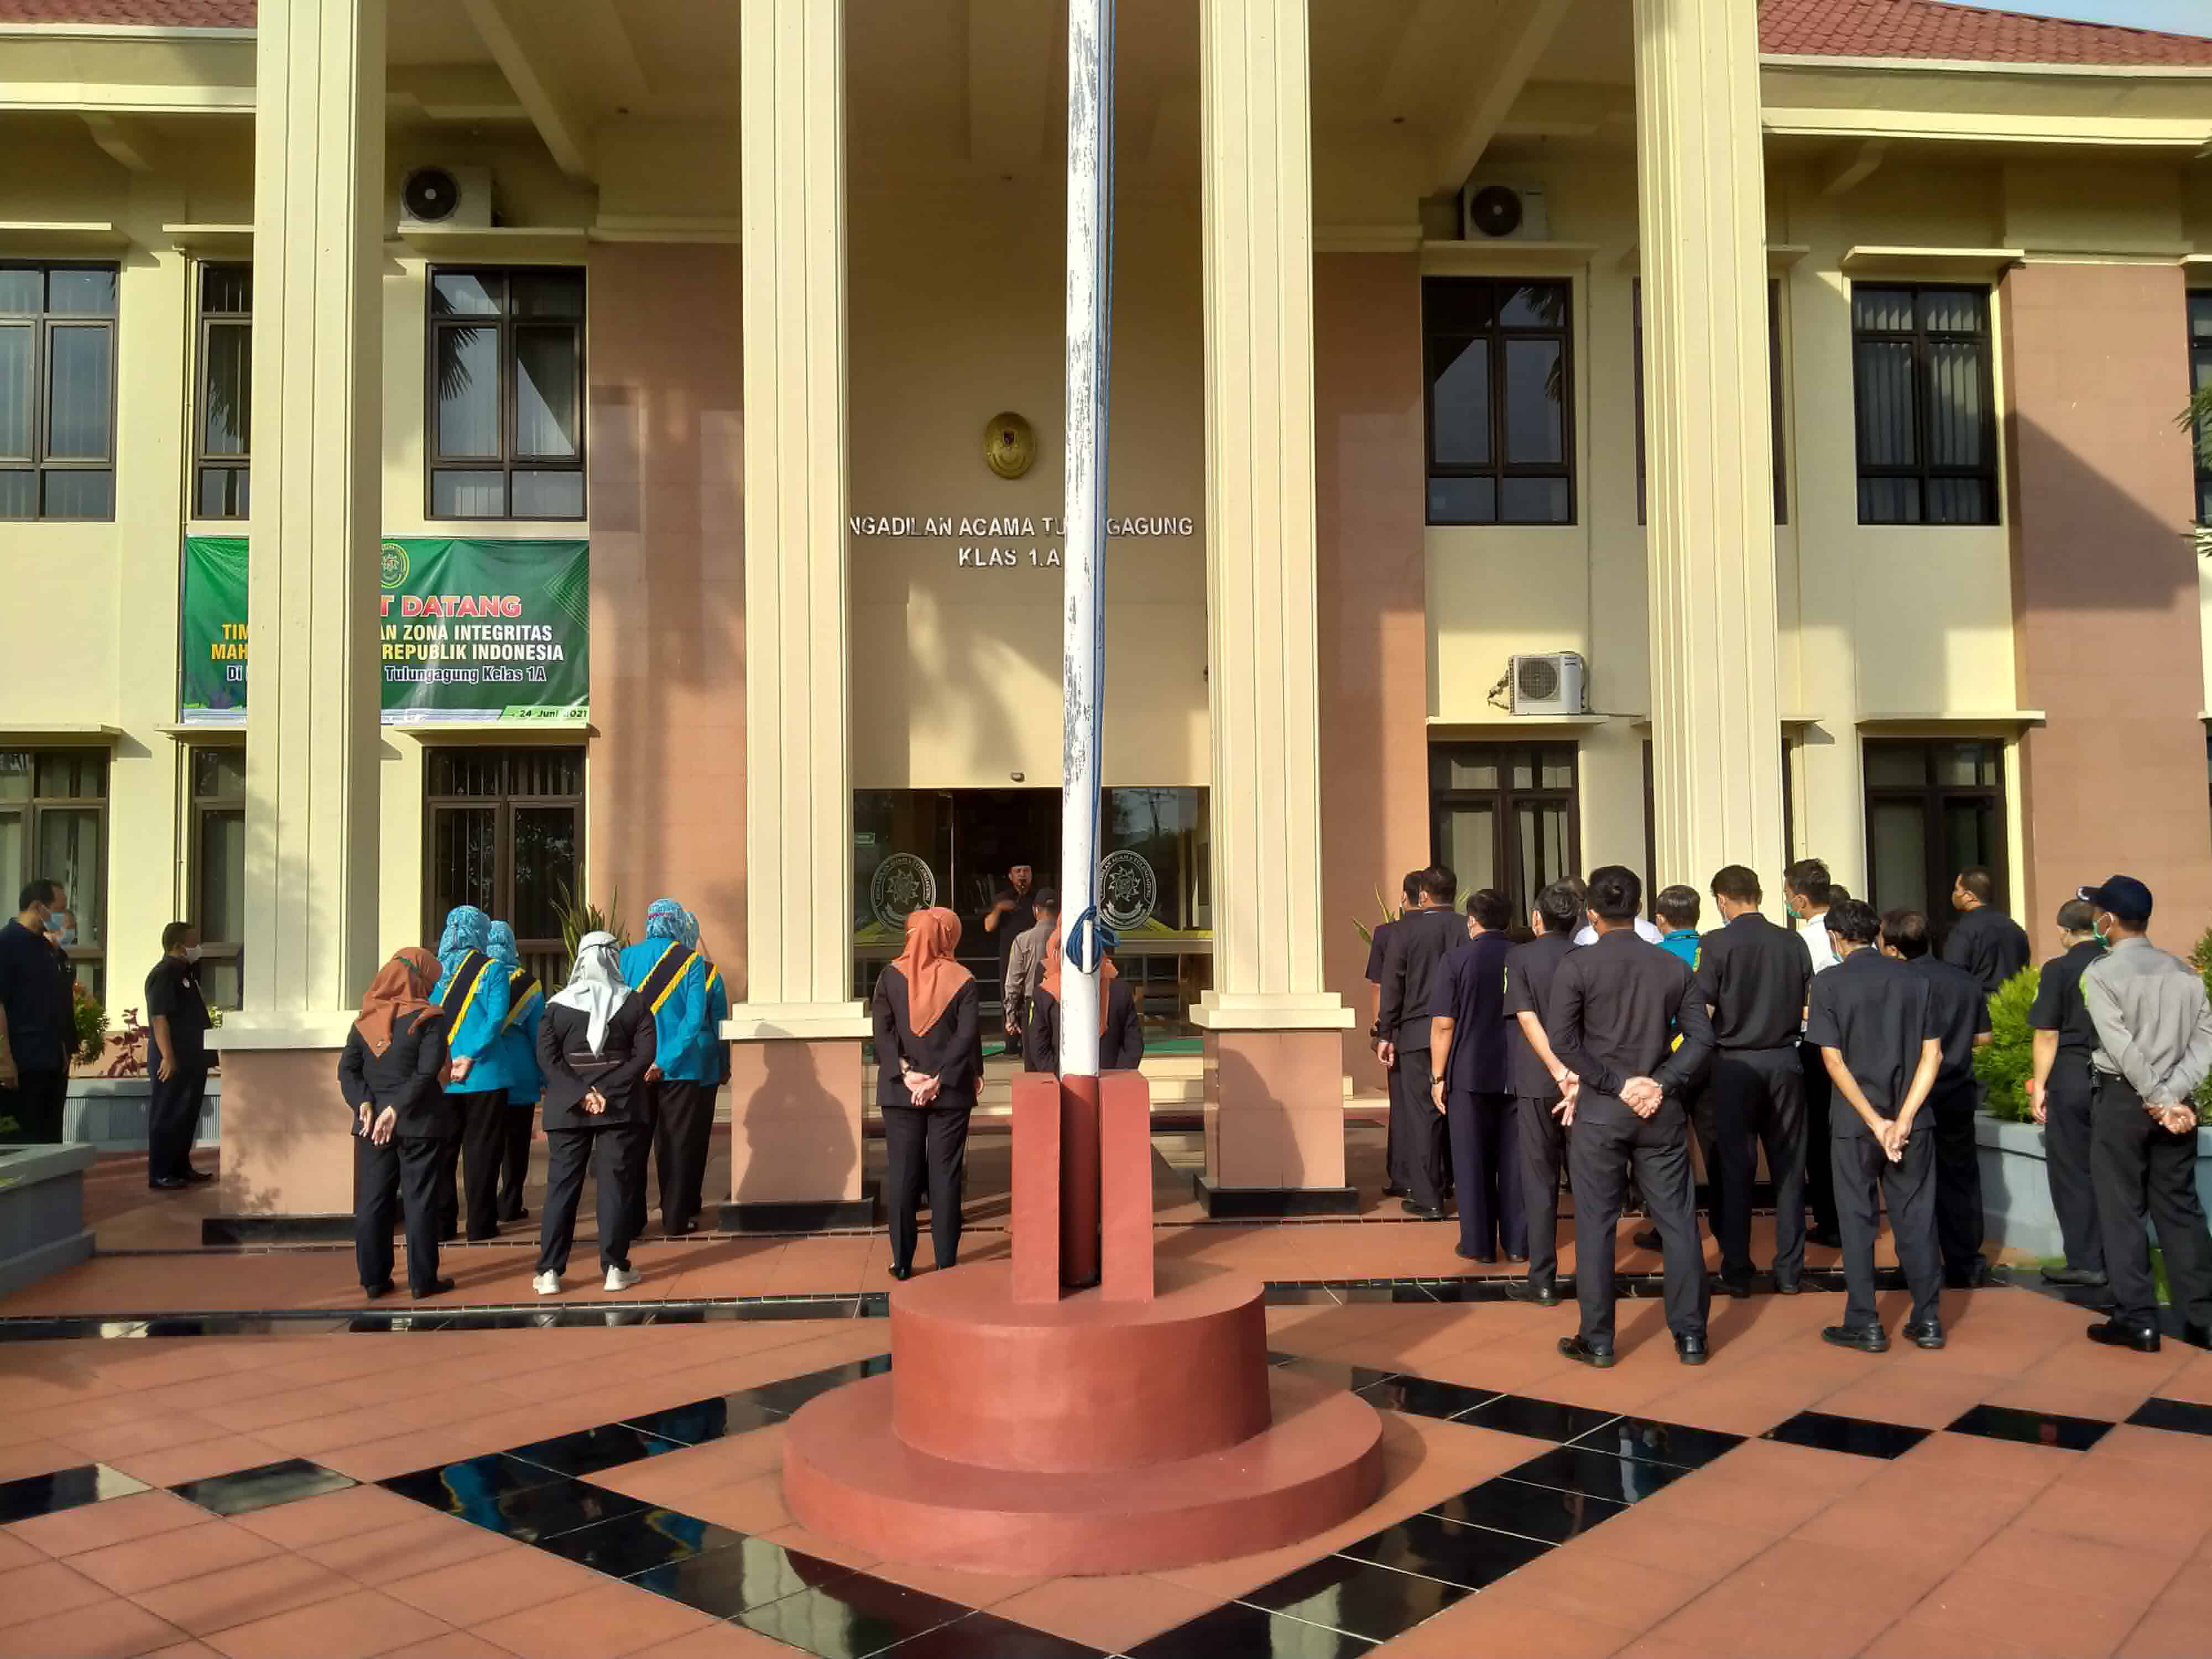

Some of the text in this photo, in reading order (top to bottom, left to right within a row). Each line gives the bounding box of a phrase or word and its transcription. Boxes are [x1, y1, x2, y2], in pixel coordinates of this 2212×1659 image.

[849, 517, 952, 536] NGADILAN
[1041, 517, 1193, 536] TUGAGUNG
[958, 547, 1060, 567] KLAS 1.A
[401, 596, 522, 618] DATANG
[403, 625, 448, 641] ZONA
[454, 625, 552, 641] INTEGRITAS
[382, 644, 467, 660] REPUBLIK
[472, 644, 564, 660] INDONESIA
[384, 666, 479, 685] Tulungagung
[482, 666, 523, 682] Kelas
[526, 666, 547, 682] 1A
